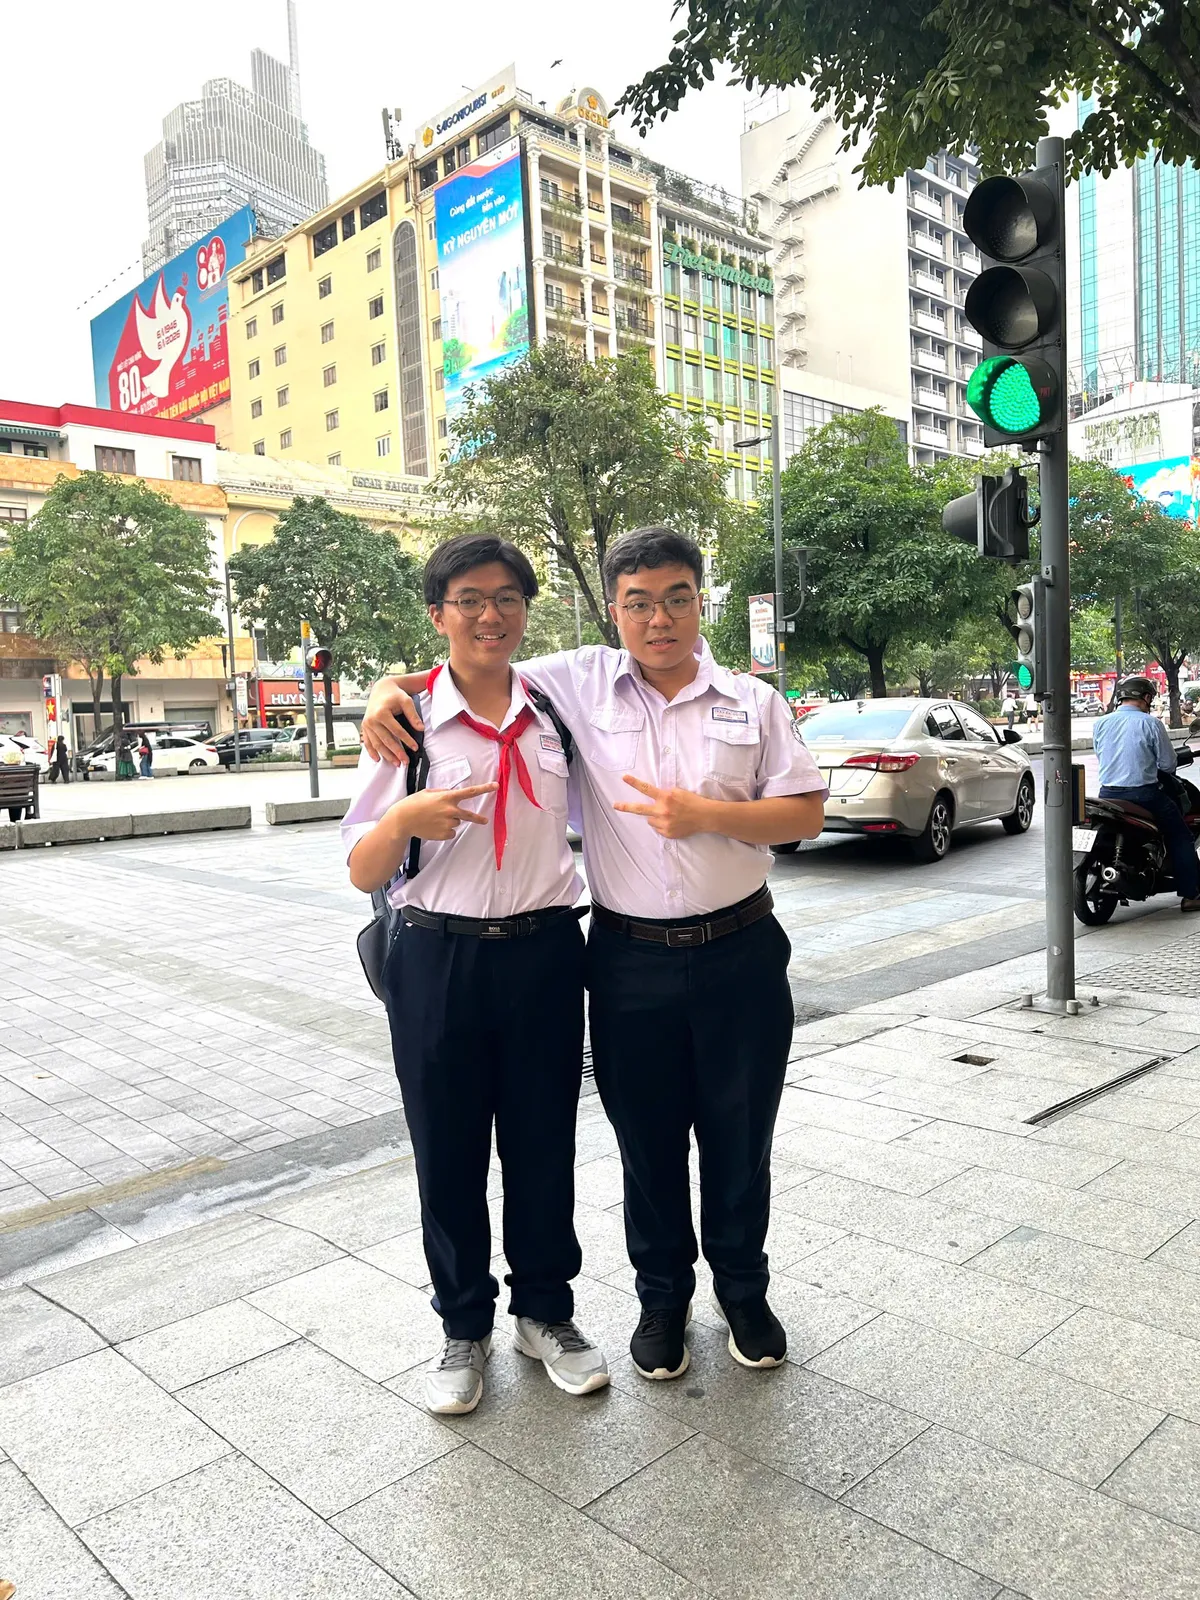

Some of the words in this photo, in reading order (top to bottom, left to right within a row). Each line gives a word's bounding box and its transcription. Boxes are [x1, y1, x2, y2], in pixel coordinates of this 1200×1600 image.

[436, 92, 487, 135] SAIGONTOURIST
[577, 105, 609, 129] OSCAR
[449, 203, 465, 218] Cùng
[457, 215, 496, 249] NGUYÊN
[118, 364, 141, 411] 80
[352, 475, 382, 490] OSCAR
[385, 480, 419, 494] SAIGON
[271, 693, 297, 705] HUY
